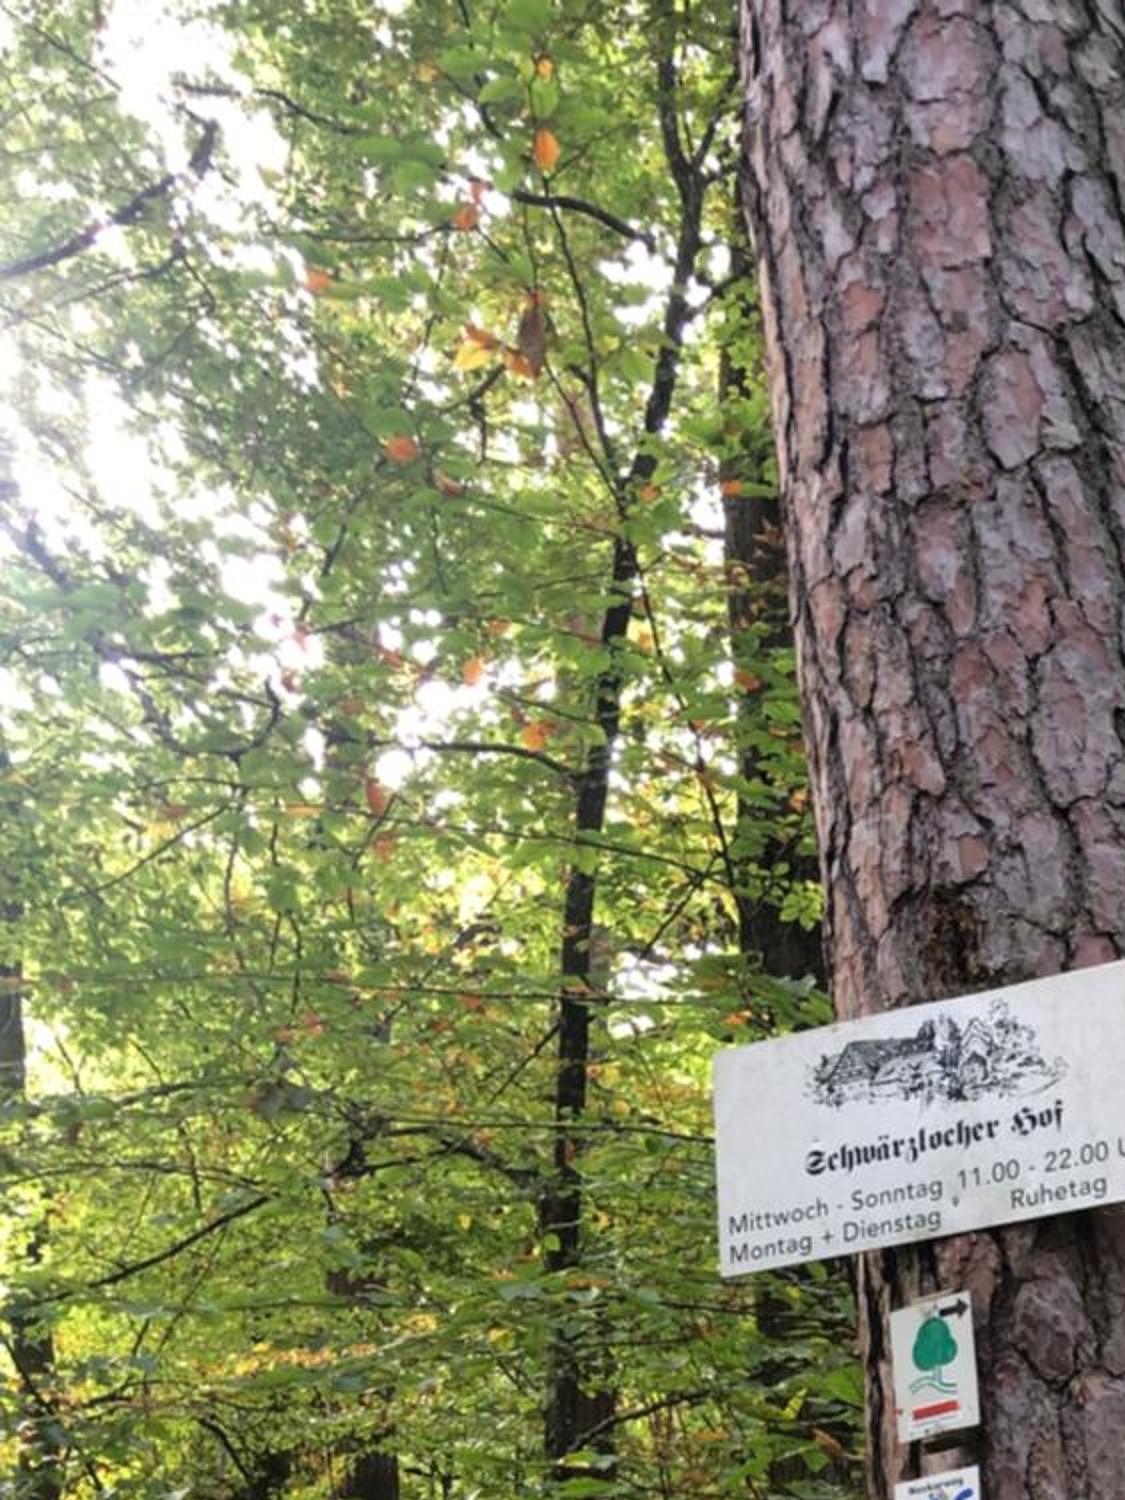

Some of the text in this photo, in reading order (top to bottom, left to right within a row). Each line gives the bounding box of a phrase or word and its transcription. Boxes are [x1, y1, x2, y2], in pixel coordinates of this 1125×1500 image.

[806, 1098, 1064, 1176] Schwärzlocher Hof
[728, 1197, 829, 1236] Mittwoch
[850, 1179, 944, 1212] Sonntag
[958, 1158, 1020, 1190] 11.00
[1044, 1140, 1109, 1173] 22.00
[729, 1176, 1108, 1265] Montag + Dienstag Ruhetag
